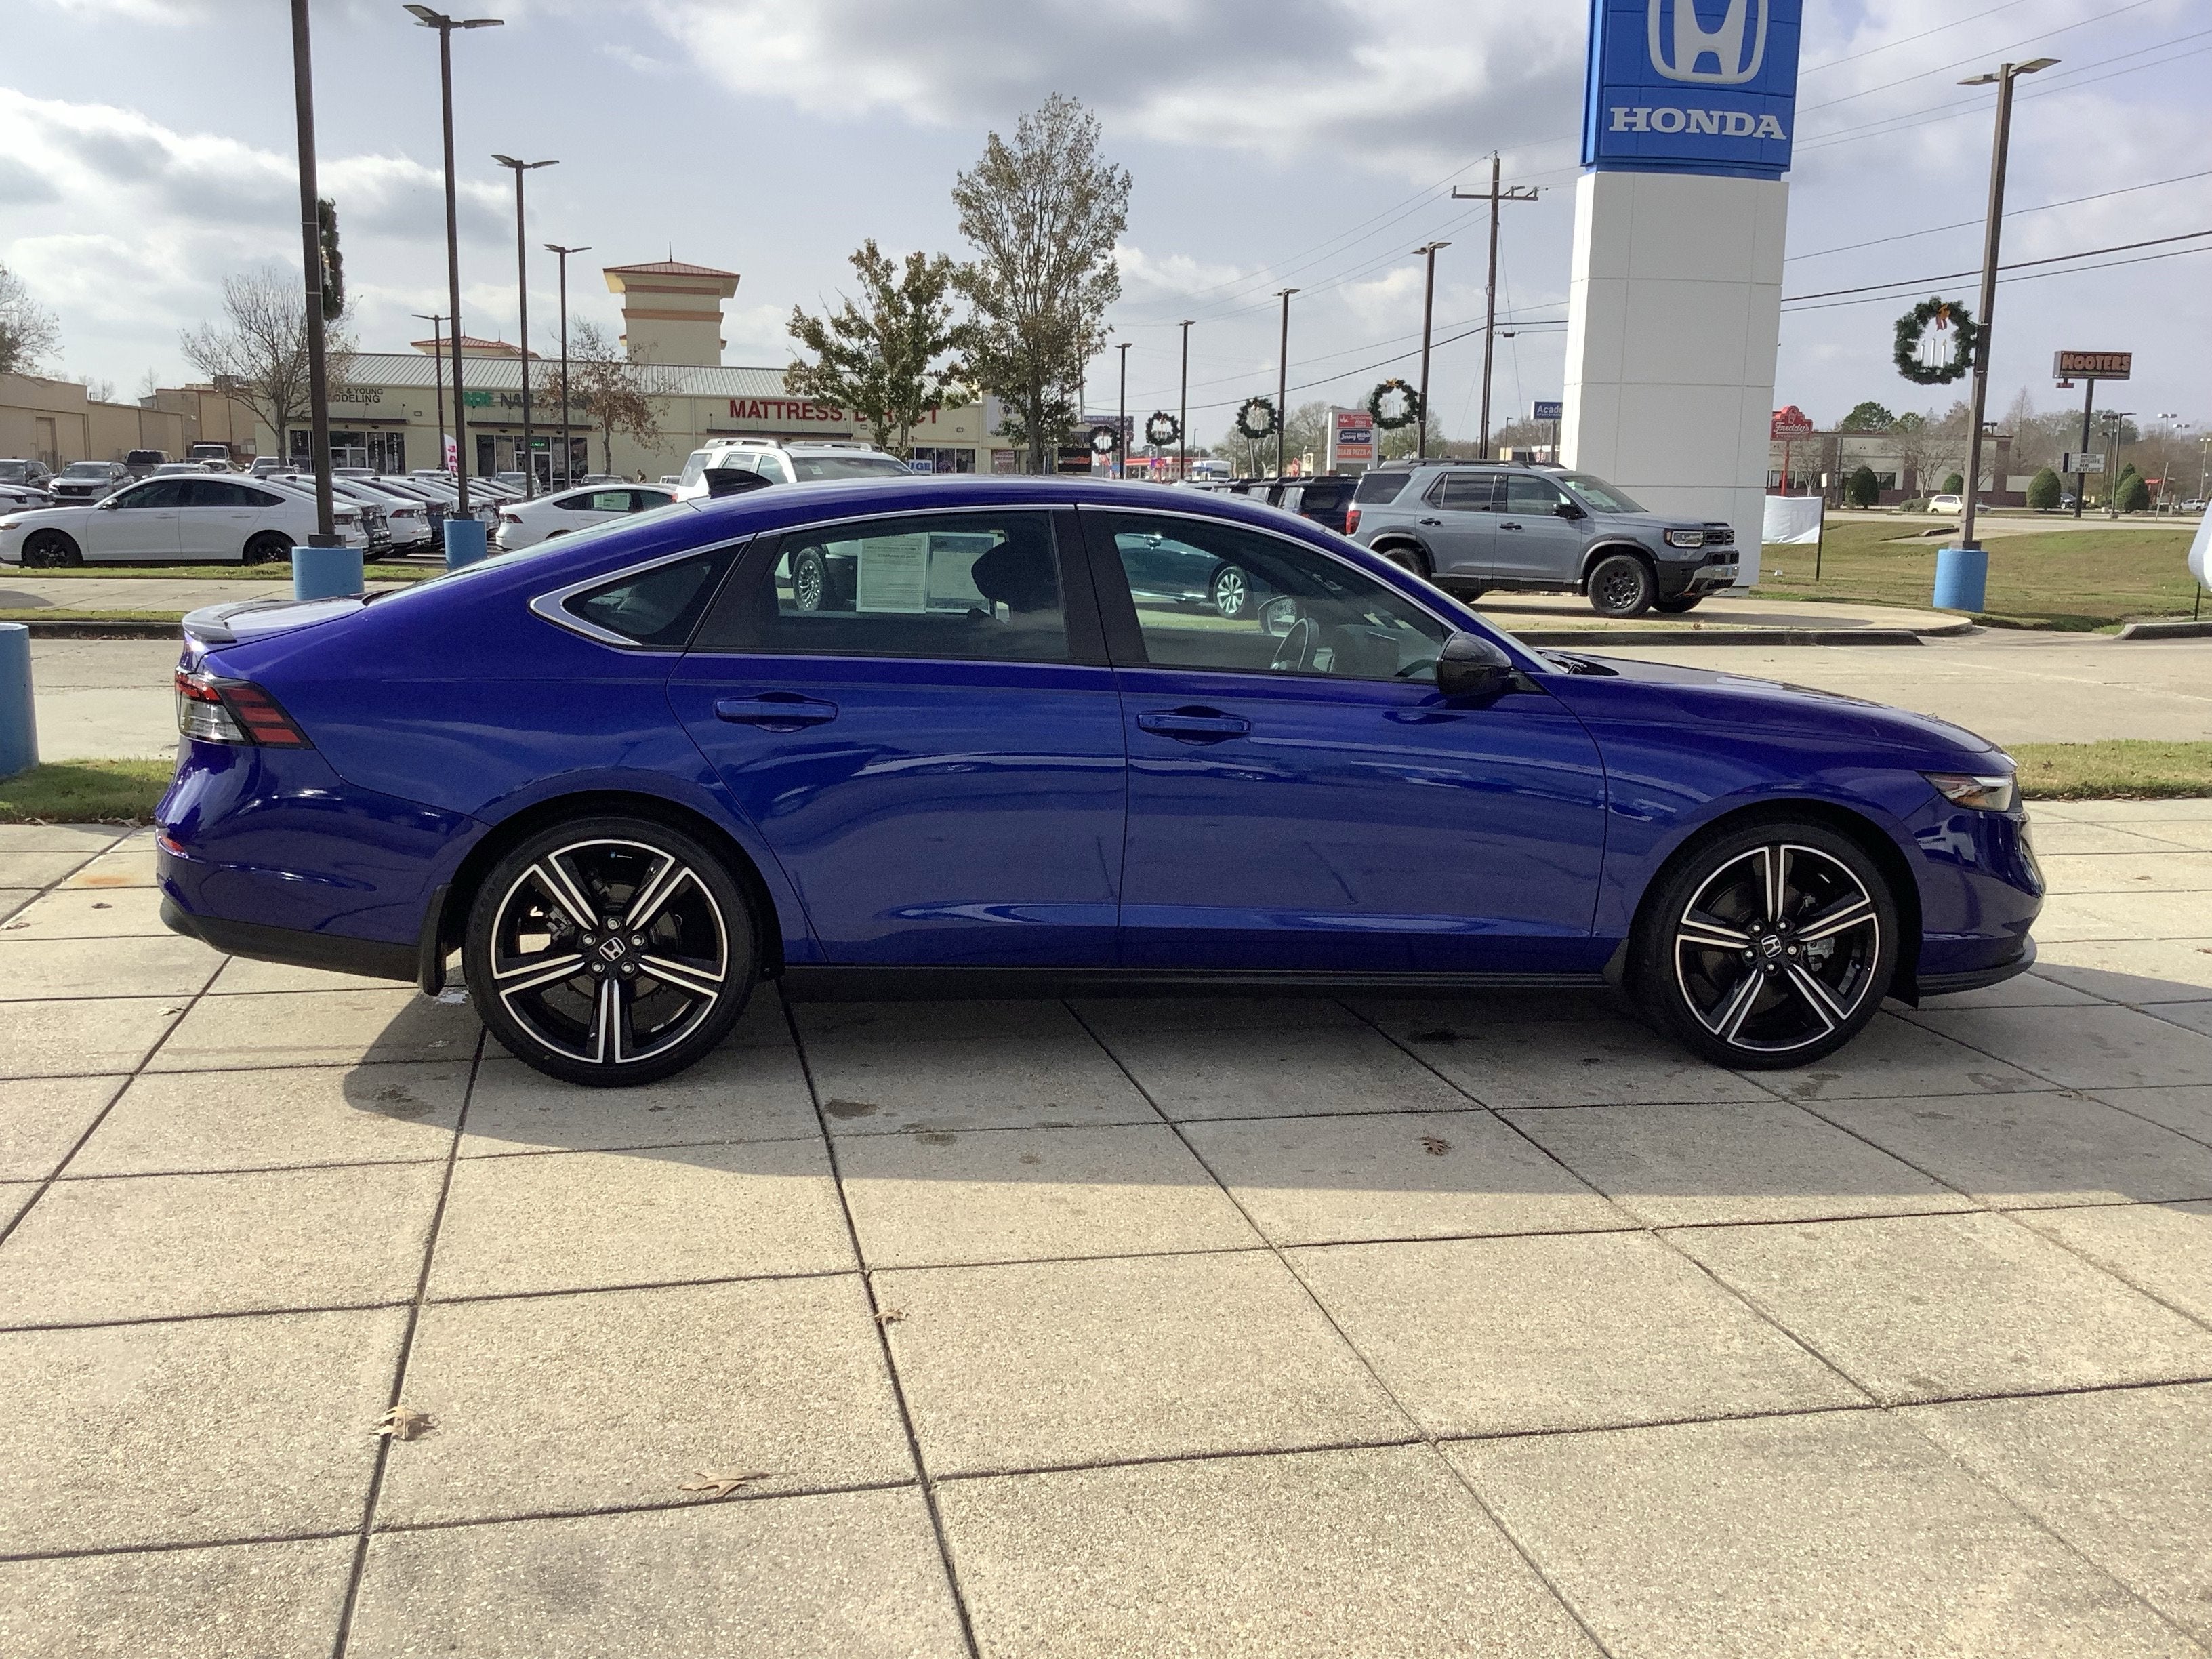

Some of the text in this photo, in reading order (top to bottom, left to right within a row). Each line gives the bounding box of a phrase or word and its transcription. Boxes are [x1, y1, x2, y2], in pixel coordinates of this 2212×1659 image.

[1608, 107, 1788, 140] HONDA
[2062, 354, 2131, 371] HOOTERS
[729, 399, 843, 422] MATTRESS
[1773, 422, 1810, 434] Freddy's
[1352, 448, 1367, 456] PIZZA
